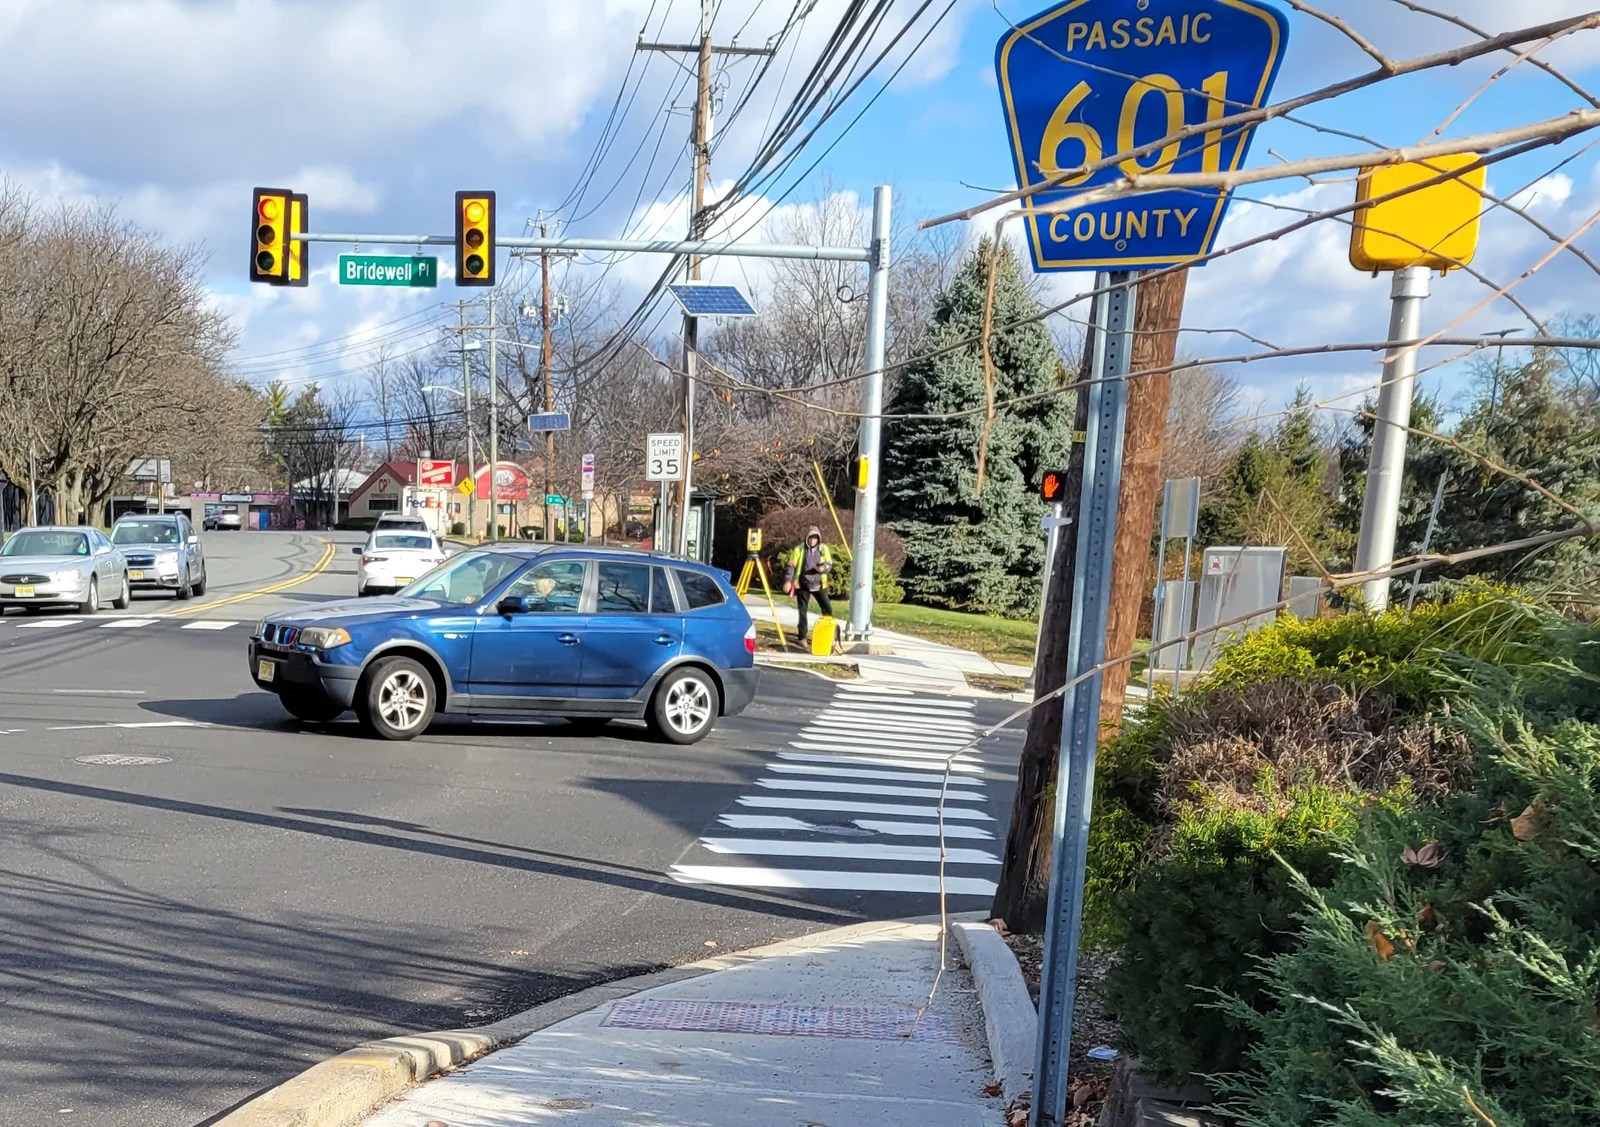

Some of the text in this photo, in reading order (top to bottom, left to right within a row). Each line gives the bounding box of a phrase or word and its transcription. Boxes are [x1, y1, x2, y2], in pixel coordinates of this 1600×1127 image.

[1067, 12, 1213, 52] PASSAIC
[1039, 71, 1229, 187] 601
[1049, 207, 1198, 243] COUNTY
[346, 260, 412, 281] Bridewell
[651, 439, 680, 447] SPEED
[651, 459, 678, 475] 35
[406, 496, 443, 509] FedEx
